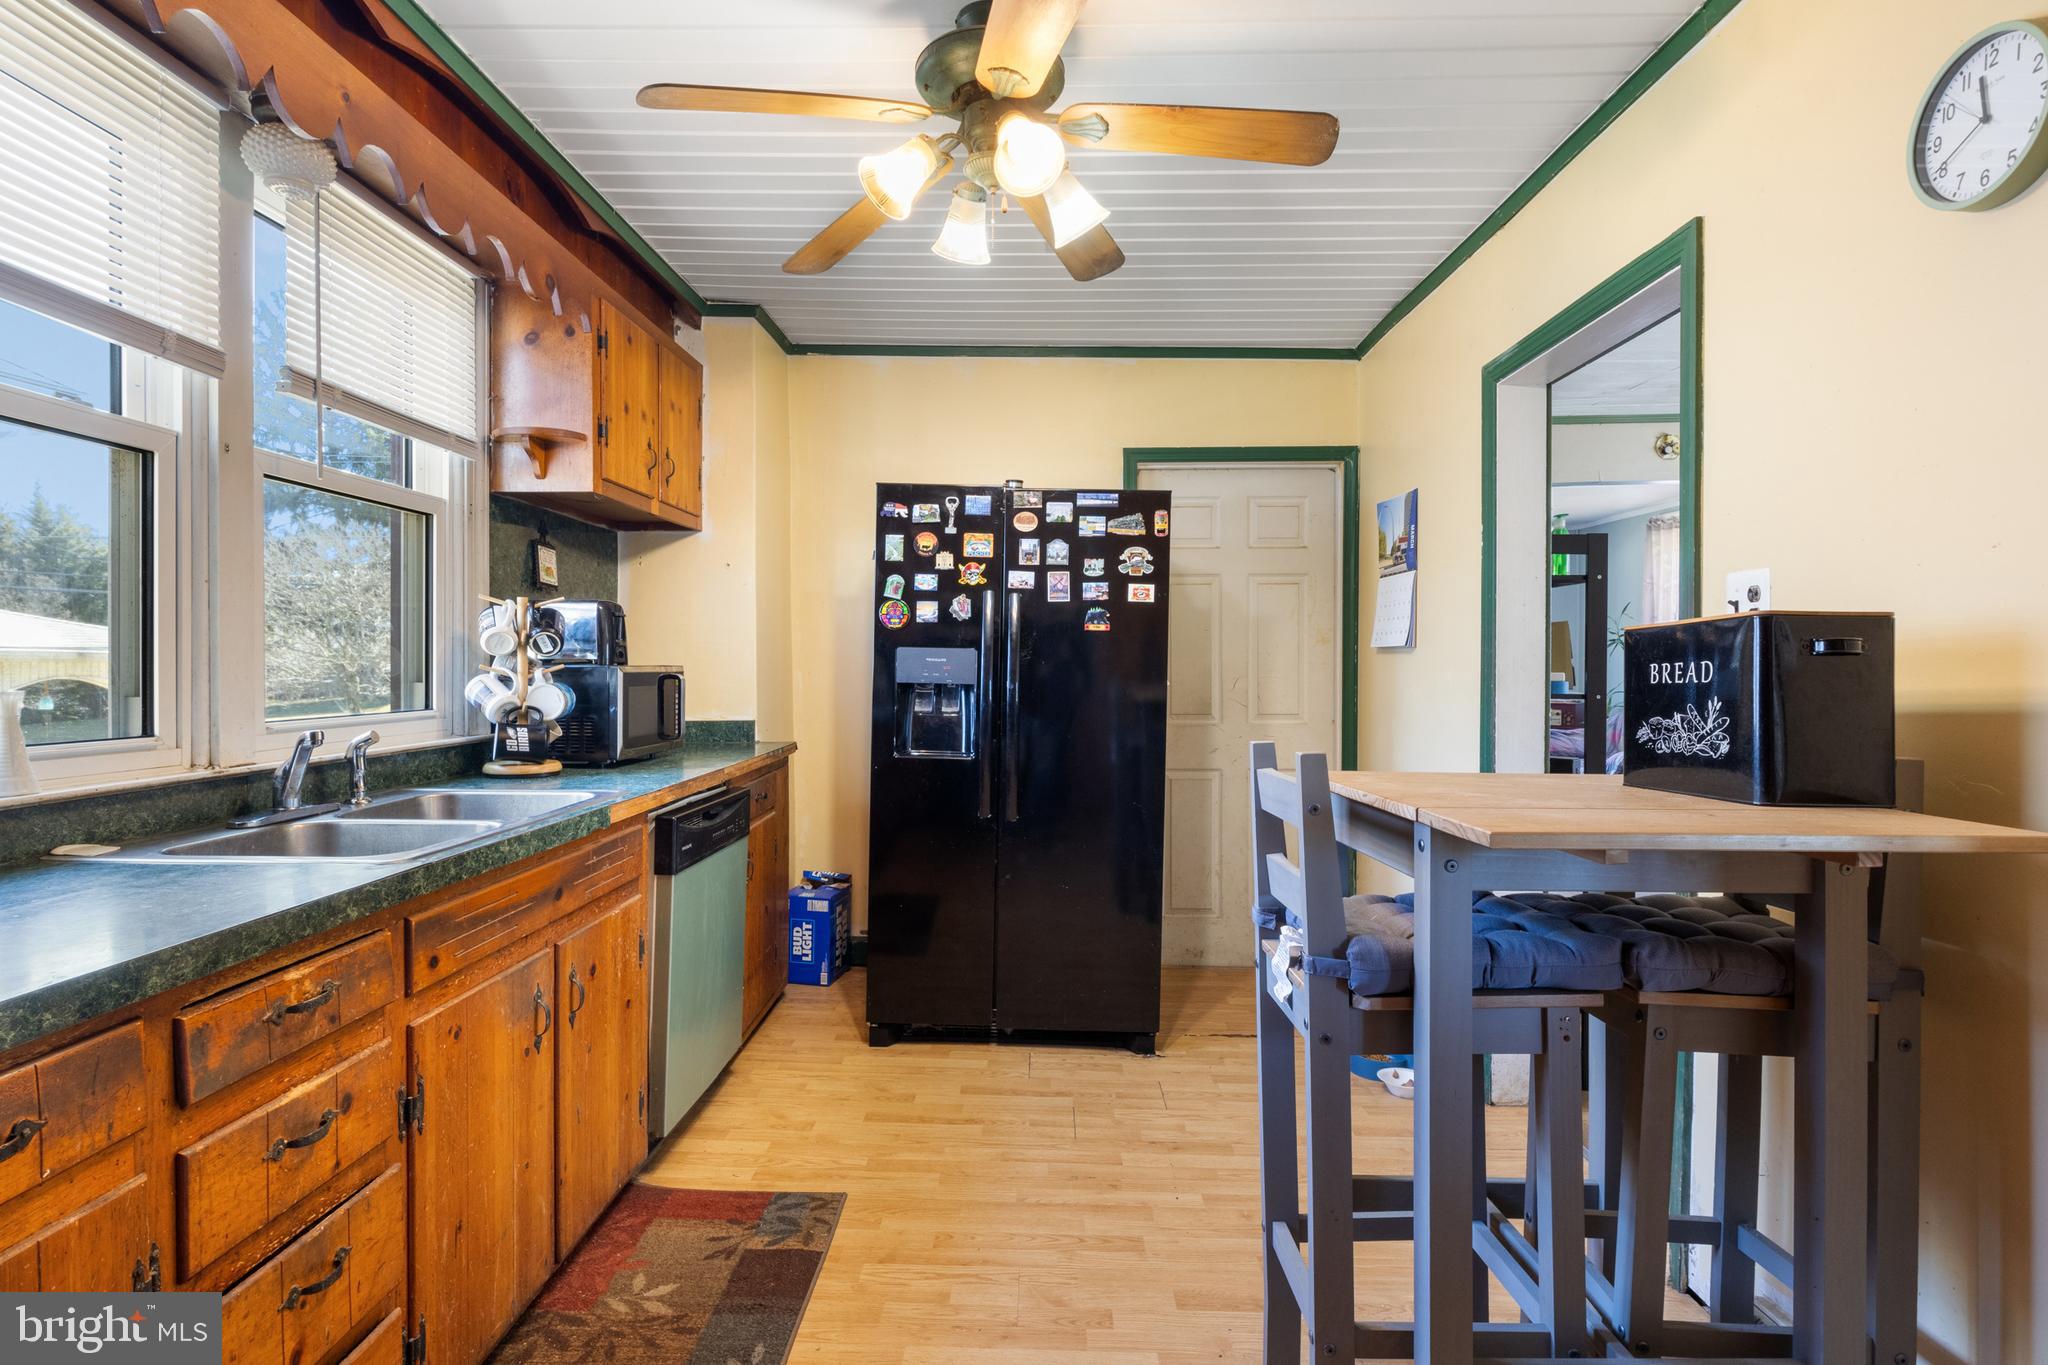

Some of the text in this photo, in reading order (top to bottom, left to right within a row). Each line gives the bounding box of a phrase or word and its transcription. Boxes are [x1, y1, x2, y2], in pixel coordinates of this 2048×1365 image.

[1984, 48, 2000, 71] 12
[2016, 42, 2021, 61] 1
[2032, 52, 2044, 74] 2
[1961, 72, 1972, 92] 11
[1942, 103, 1956, 125] 10
[2028, 115, 2039, 134] 4
[1933, 136, 1943, 153] 9
[2006, 148, 2018, 168] 5
[1938, 161, 1948, 179] 8
[1979, 168, 1990, 187] 6
[1956, 172, 1966, 190] 7
[1649, 660, 1714, 685] BREAD
[793, 926, 803, 956] BUD
[802, 922, 812, 962] LIGHT
